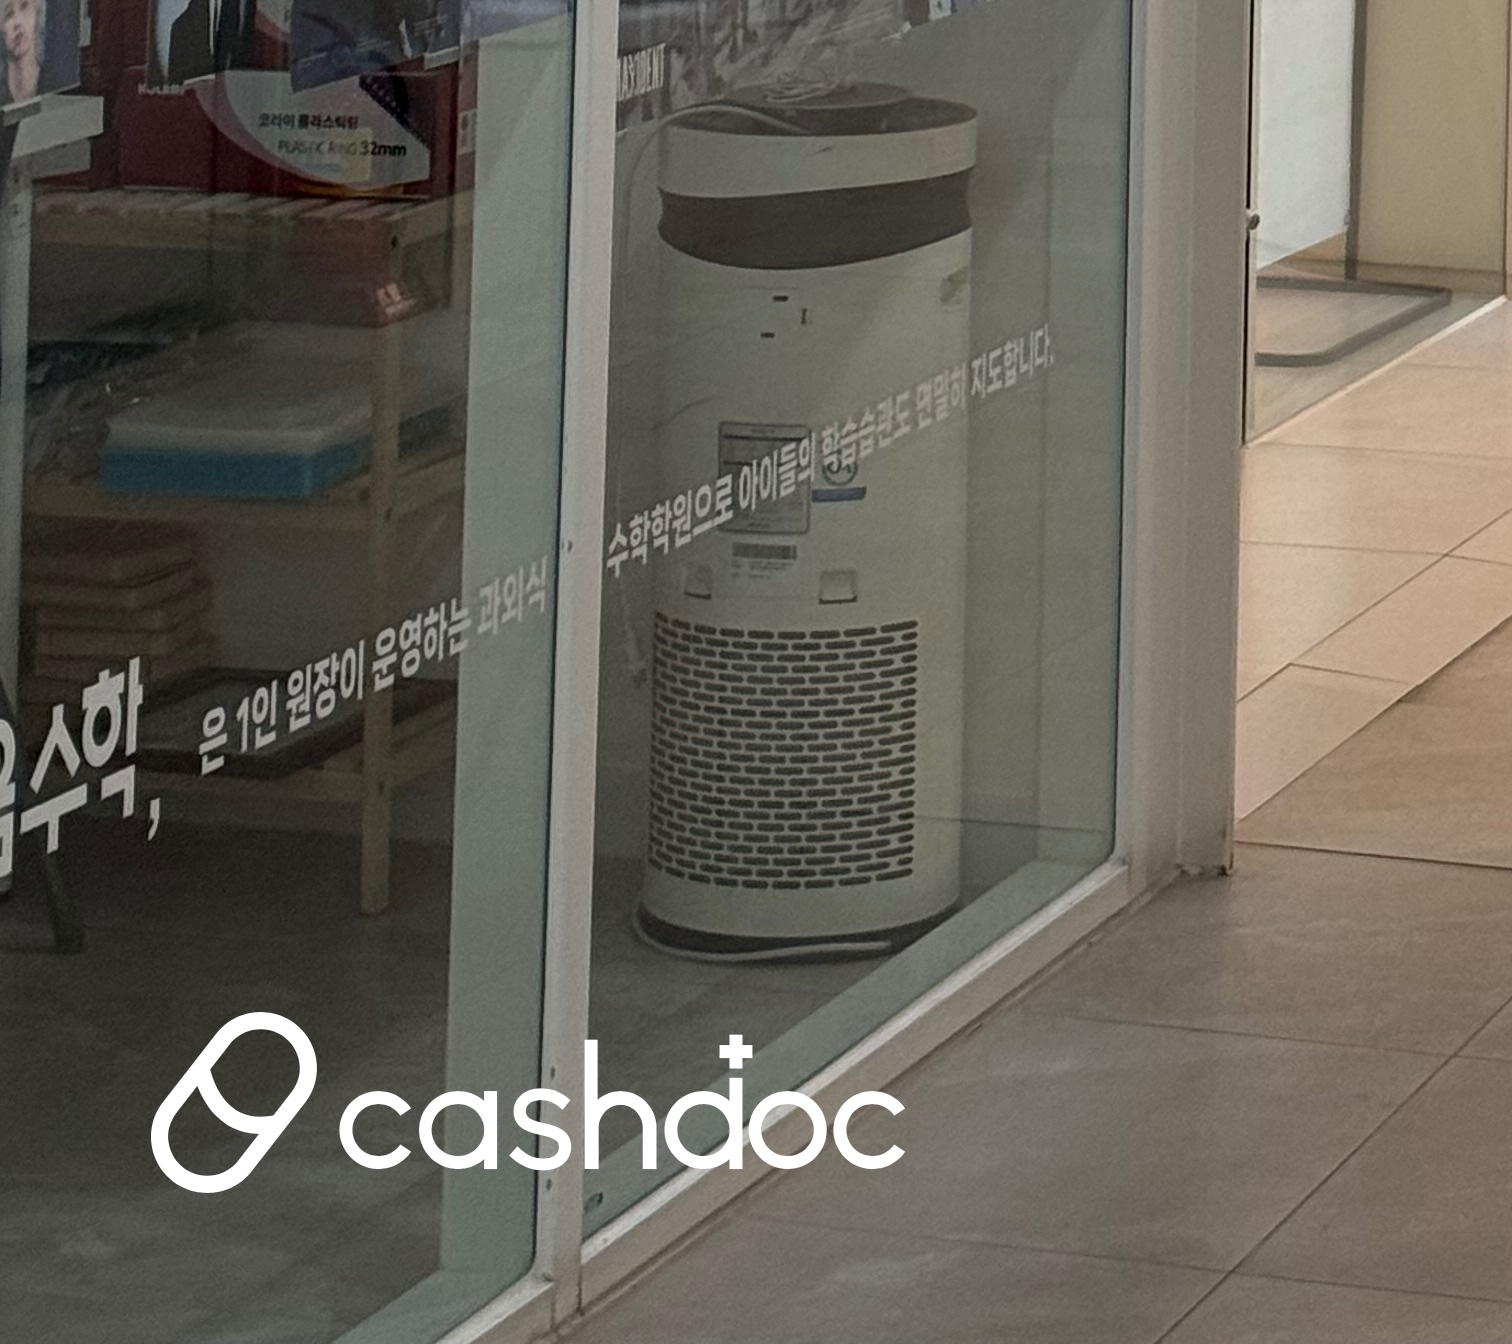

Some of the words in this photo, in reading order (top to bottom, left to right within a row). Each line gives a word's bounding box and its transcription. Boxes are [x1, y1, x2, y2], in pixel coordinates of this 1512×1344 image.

[360, 141, 407, 156] 32mm
[606, 472, 733, 578] 수학학원으로
[739, 431, 815, 512] 아이들의
[970, 323, 1055, 399] 지도합니다.
[0, 656, 160, 878] 수학,
[199, 706, 227, 775] 은
[236, 680, 277, 753] 1인
[284, 640, 364, 734] 원장이
[371, 597, 469, 692] 운영하는
[476, 555, 548, 636] 과외식
